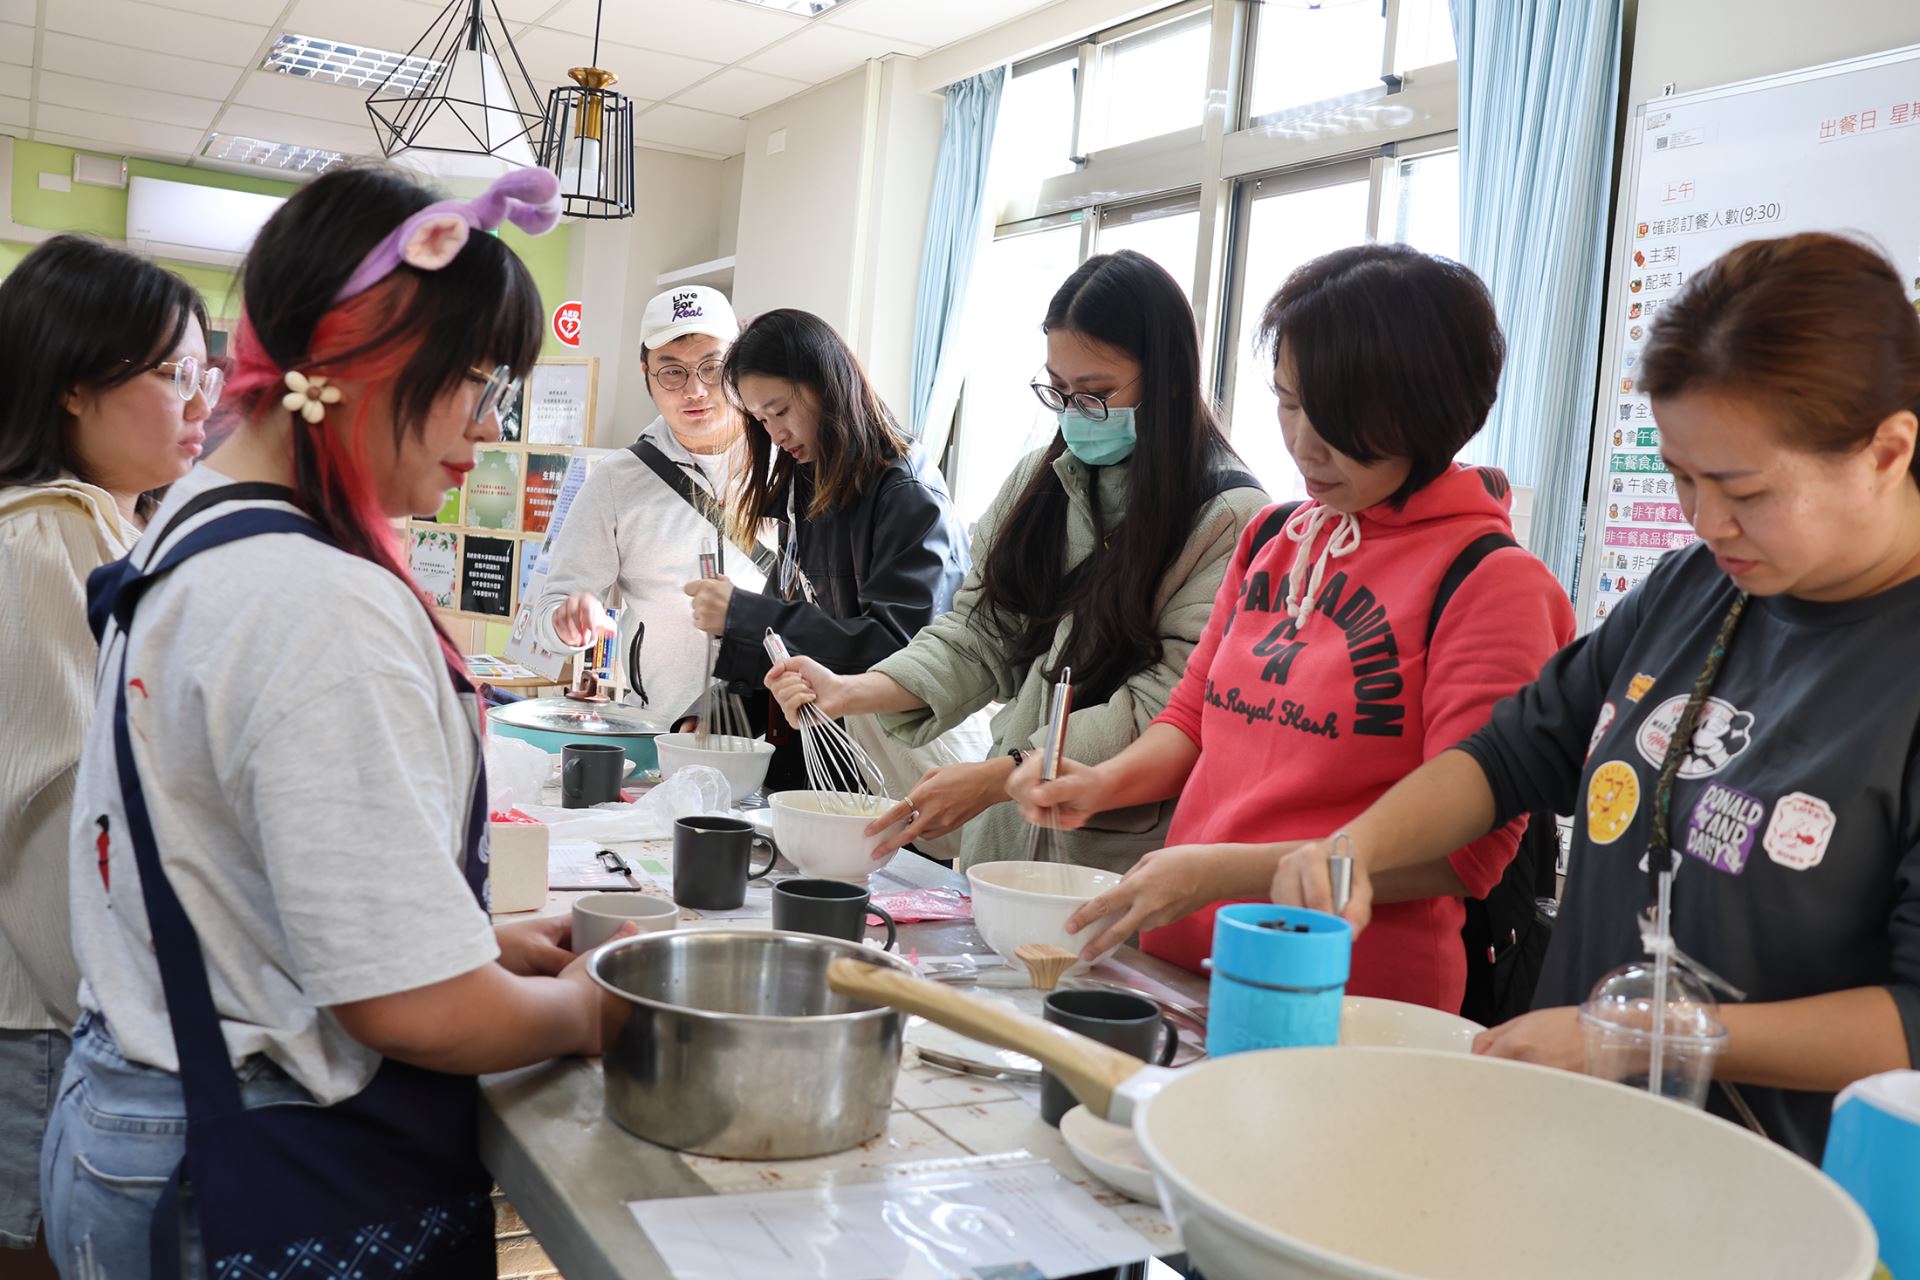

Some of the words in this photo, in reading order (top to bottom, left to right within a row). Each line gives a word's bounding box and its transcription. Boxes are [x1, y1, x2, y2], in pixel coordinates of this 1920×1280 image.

[1819, 109, 1877, 139] 出餐日
[1661, 181, 1694, 202] 上午
[1648, 246, 1678, 264] 主菜
[1645, 272, 1672, 290] 配菜
[561, 309, 580, 319] AED
[672, 306, 702, 321] Real
[1635, 403, 1654, 419] 全
[1611, 454, 1669, 471] 午餐食品
[1222, 687, 1274, 725] Royal
[1278, 699, 1339, 740] Flesh
[1701, 785, 1763, 825] DONALD
[1705, 812, 1748, 846] AND
[1686, 826, 1725, 865] DAISY
